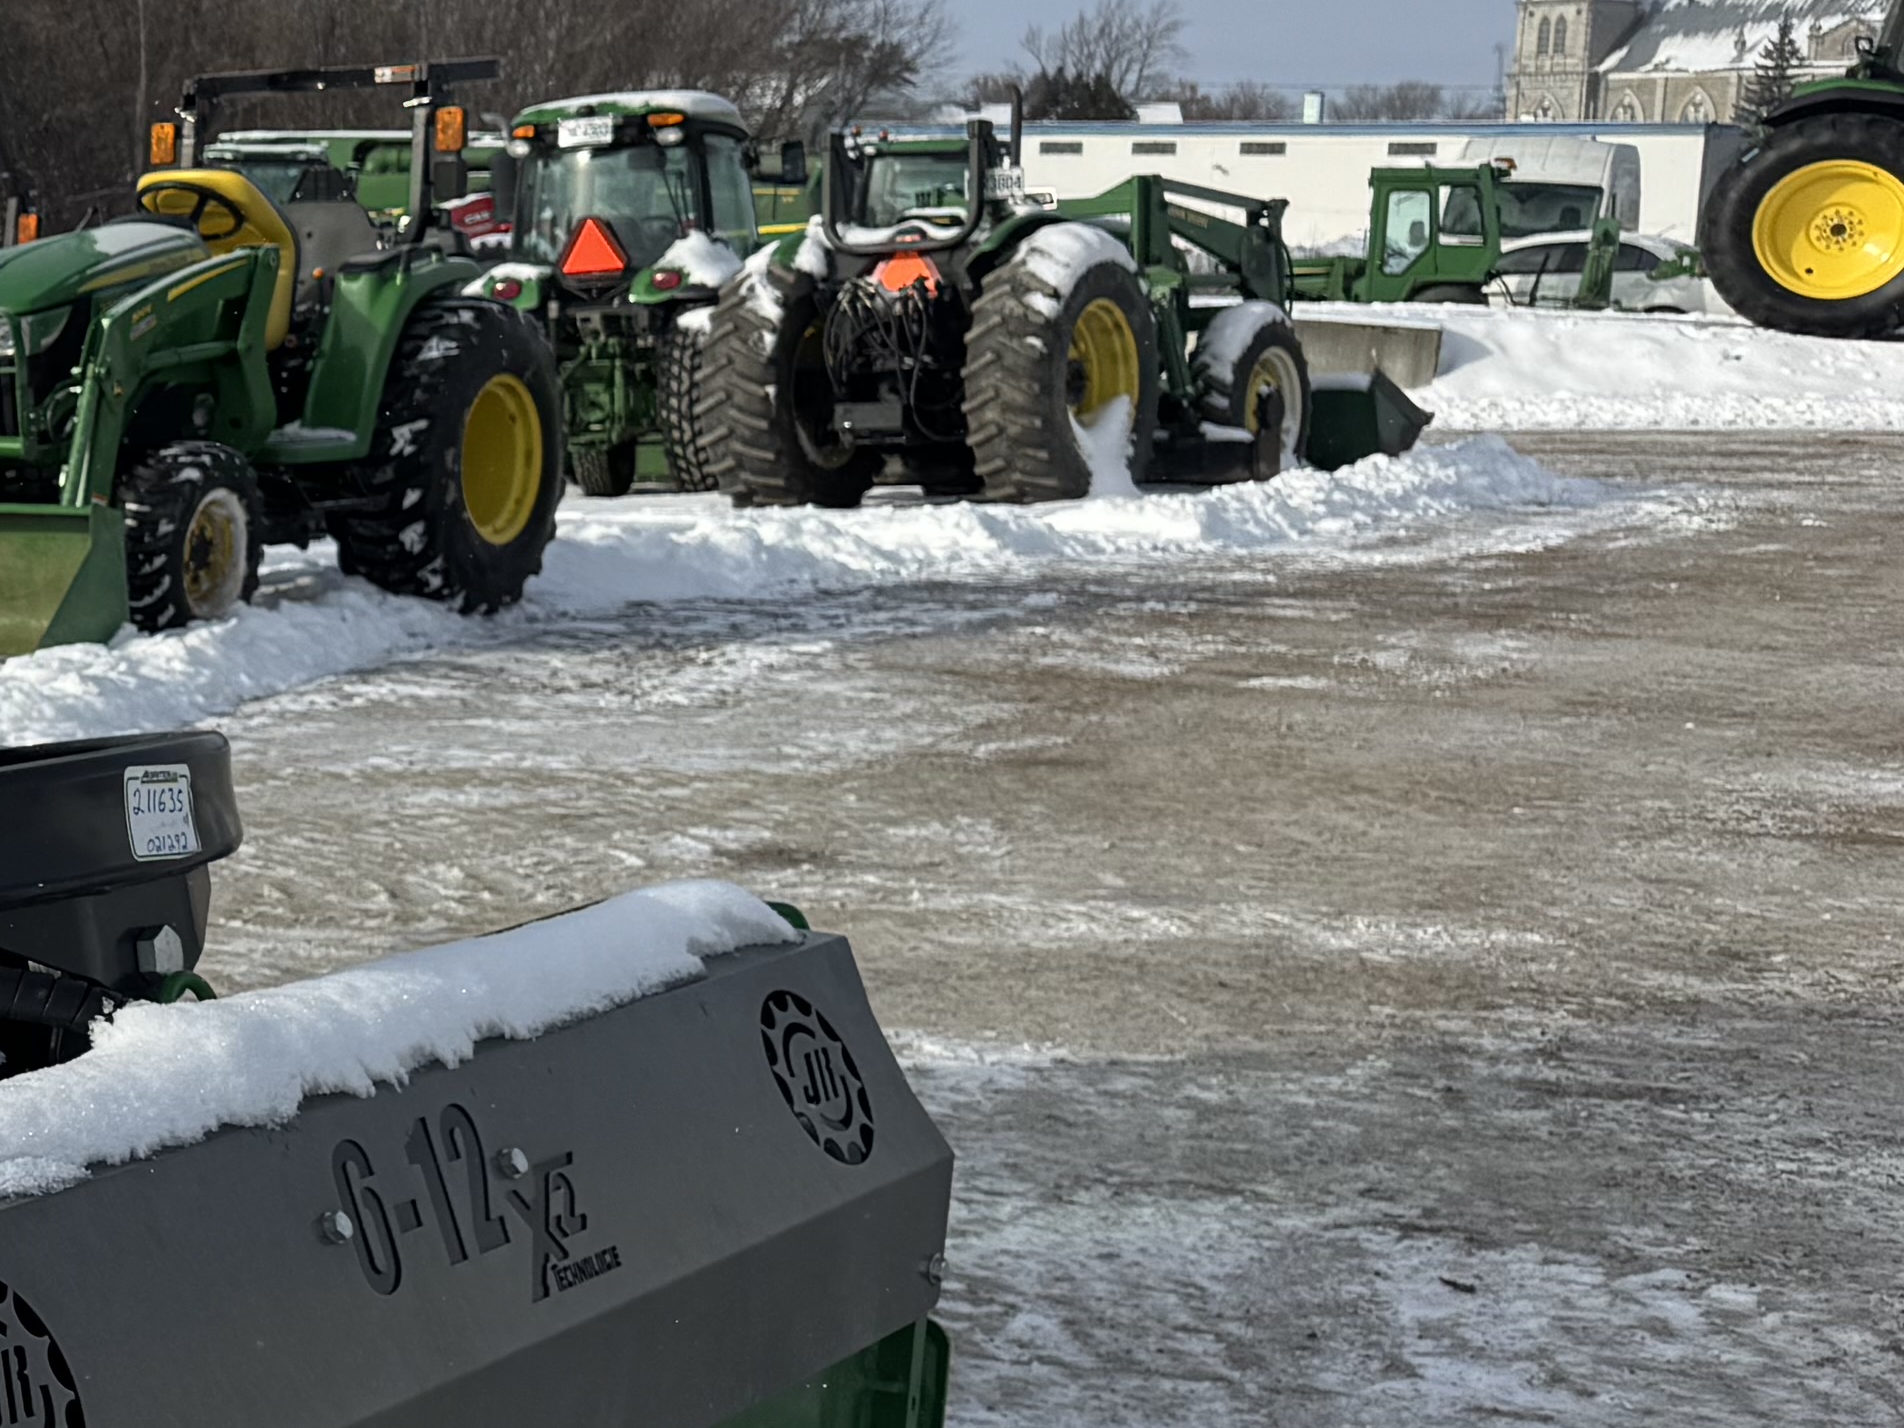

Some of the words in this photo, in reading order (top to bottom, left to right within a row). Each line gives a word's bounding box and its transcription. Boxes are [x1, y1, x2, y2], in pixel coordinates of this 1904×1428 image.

[803, 1046, 840, 1106] JR
[331, 1103, 511, 1296] 6-12
[550, 1245, 622, 1292] TECHNOLOGIE
